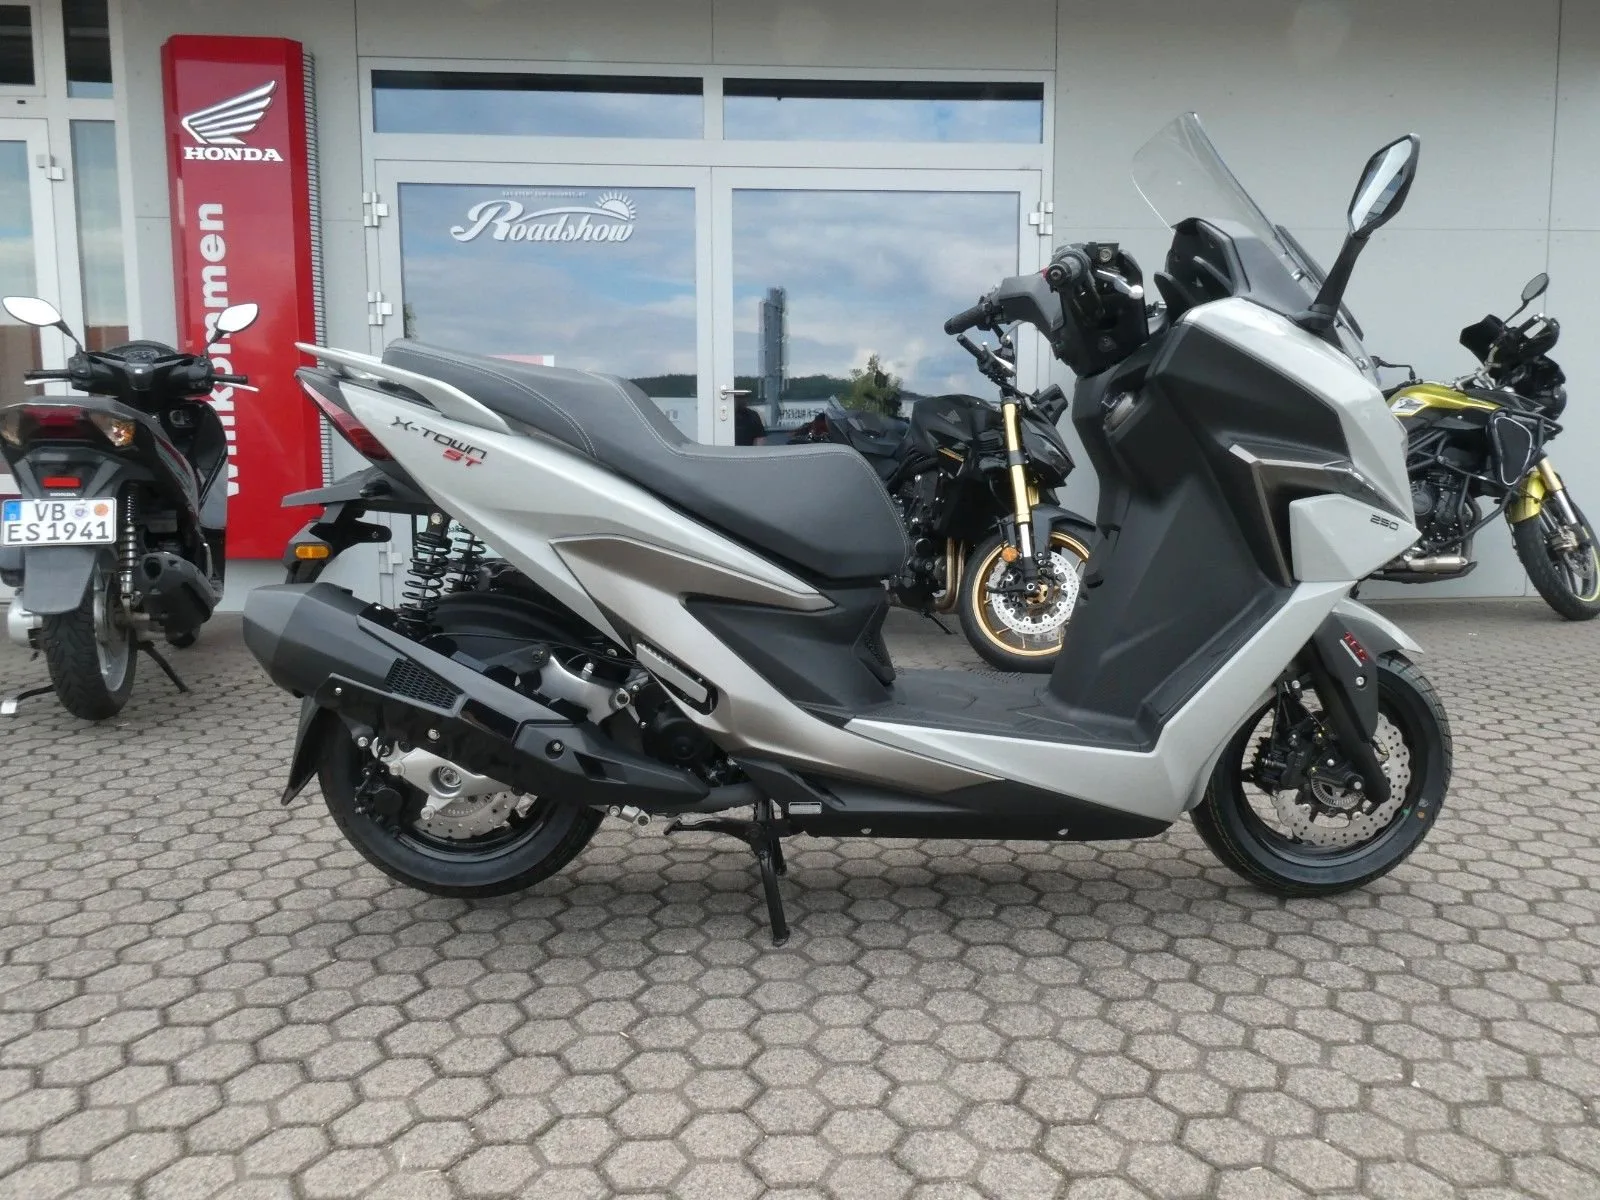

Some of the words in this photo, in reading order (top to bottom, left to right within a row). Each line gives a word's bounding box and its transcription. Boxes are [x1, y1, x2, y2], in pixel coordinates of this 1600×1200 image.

[184, 147, 284, 162] HONDA
[450, 199, 634, 242] Roadshow
[442, 448, 482, 467] ST
[35, 503, 66, 521] VB
[1370, 513, 1399, 531] 250
